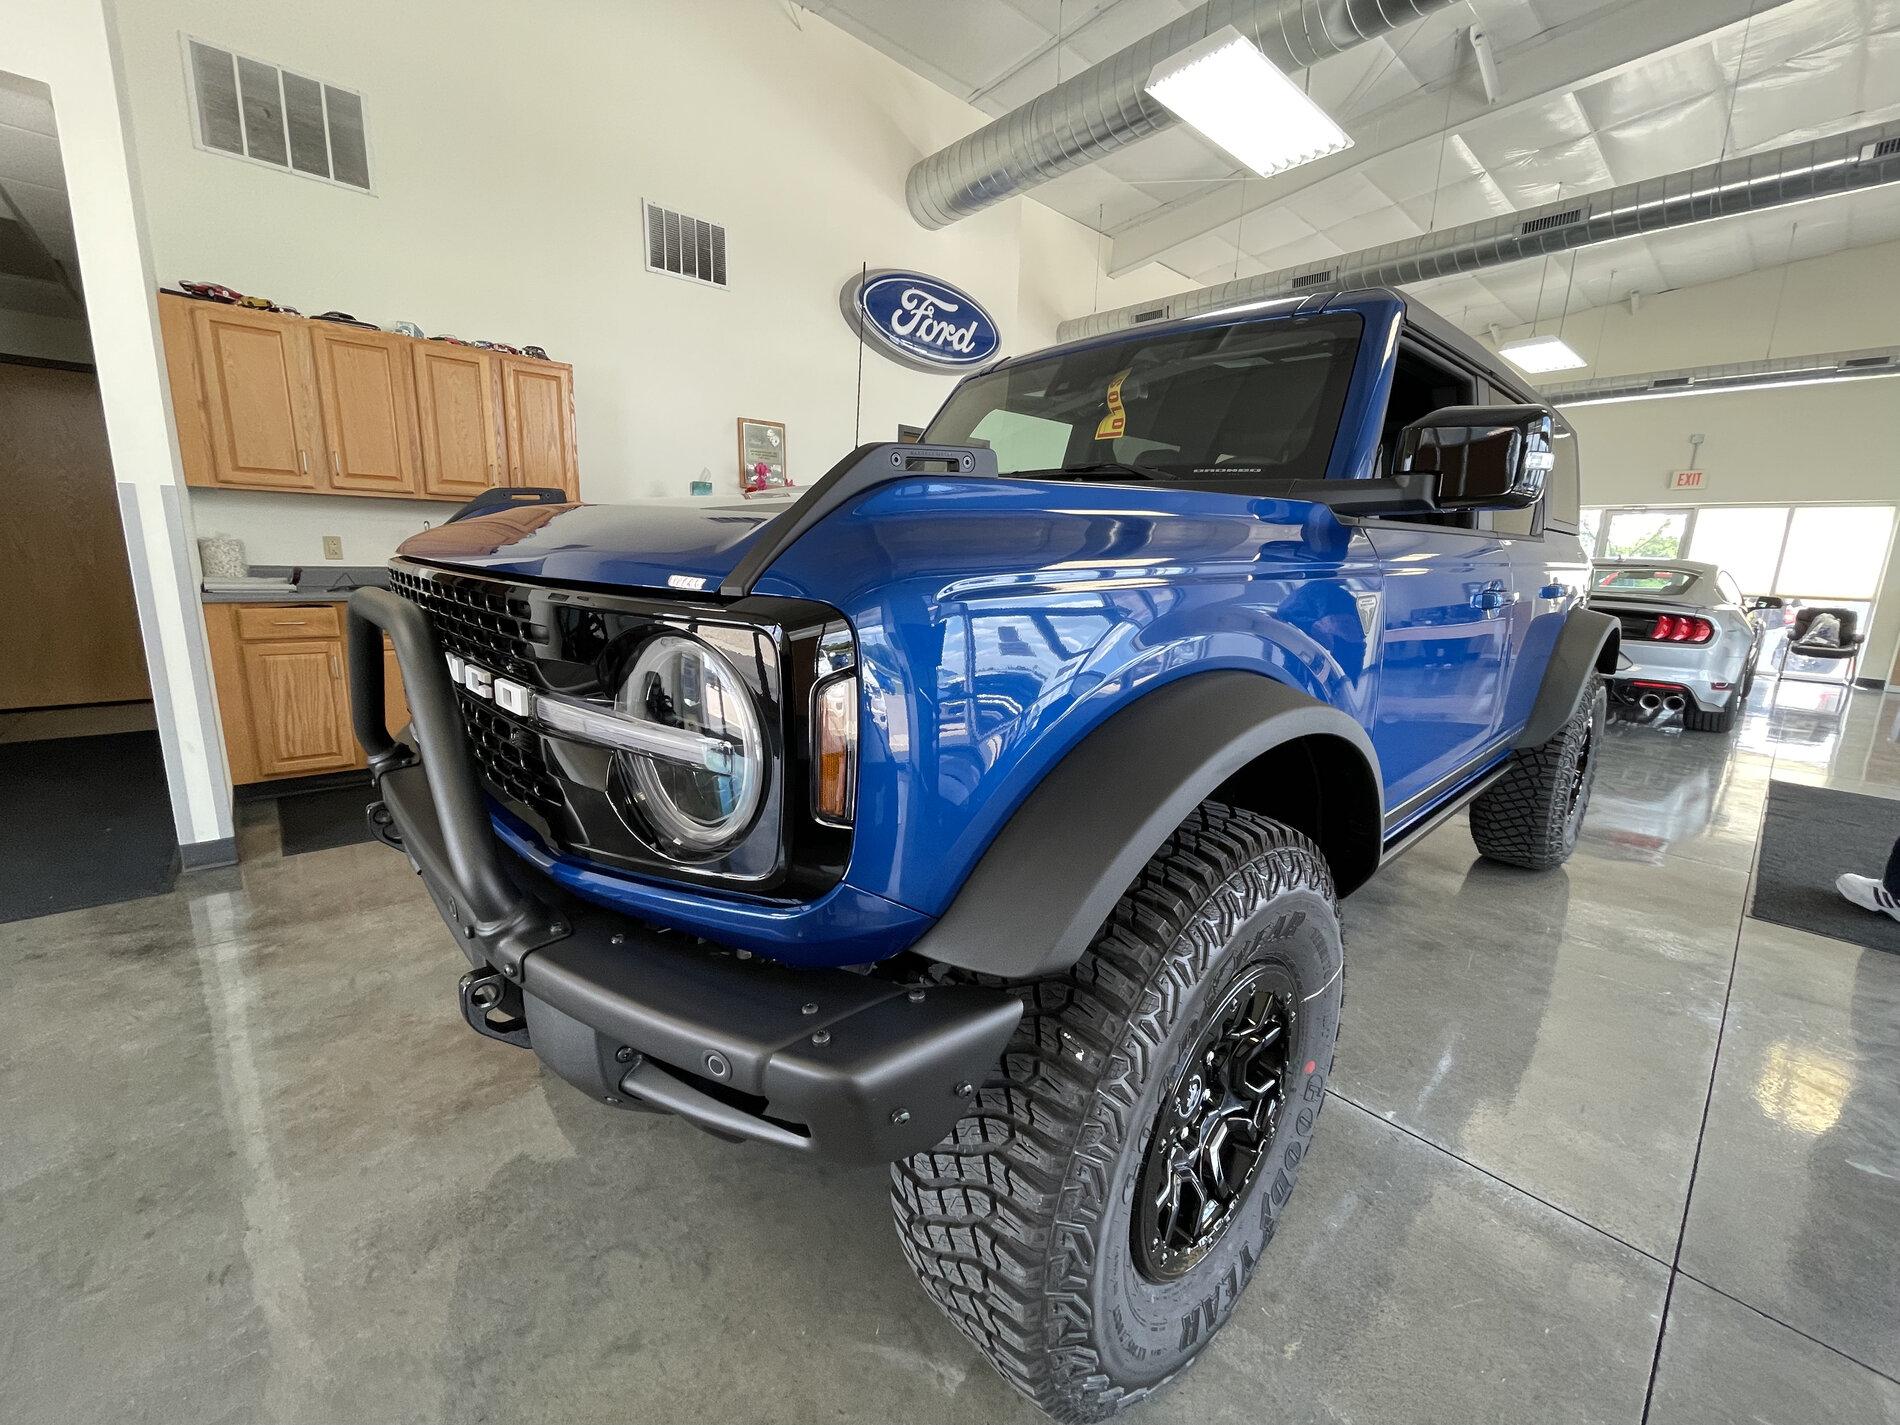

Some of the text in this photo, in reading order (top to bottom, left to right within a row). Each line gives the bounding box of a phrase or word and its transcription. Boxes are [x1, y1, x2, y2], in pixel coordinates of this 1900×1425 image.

[891, 288, 979, 353] Ford
[1677, 472, 1703, 486] EXIT
[445, 651, 529, 717] NCO
